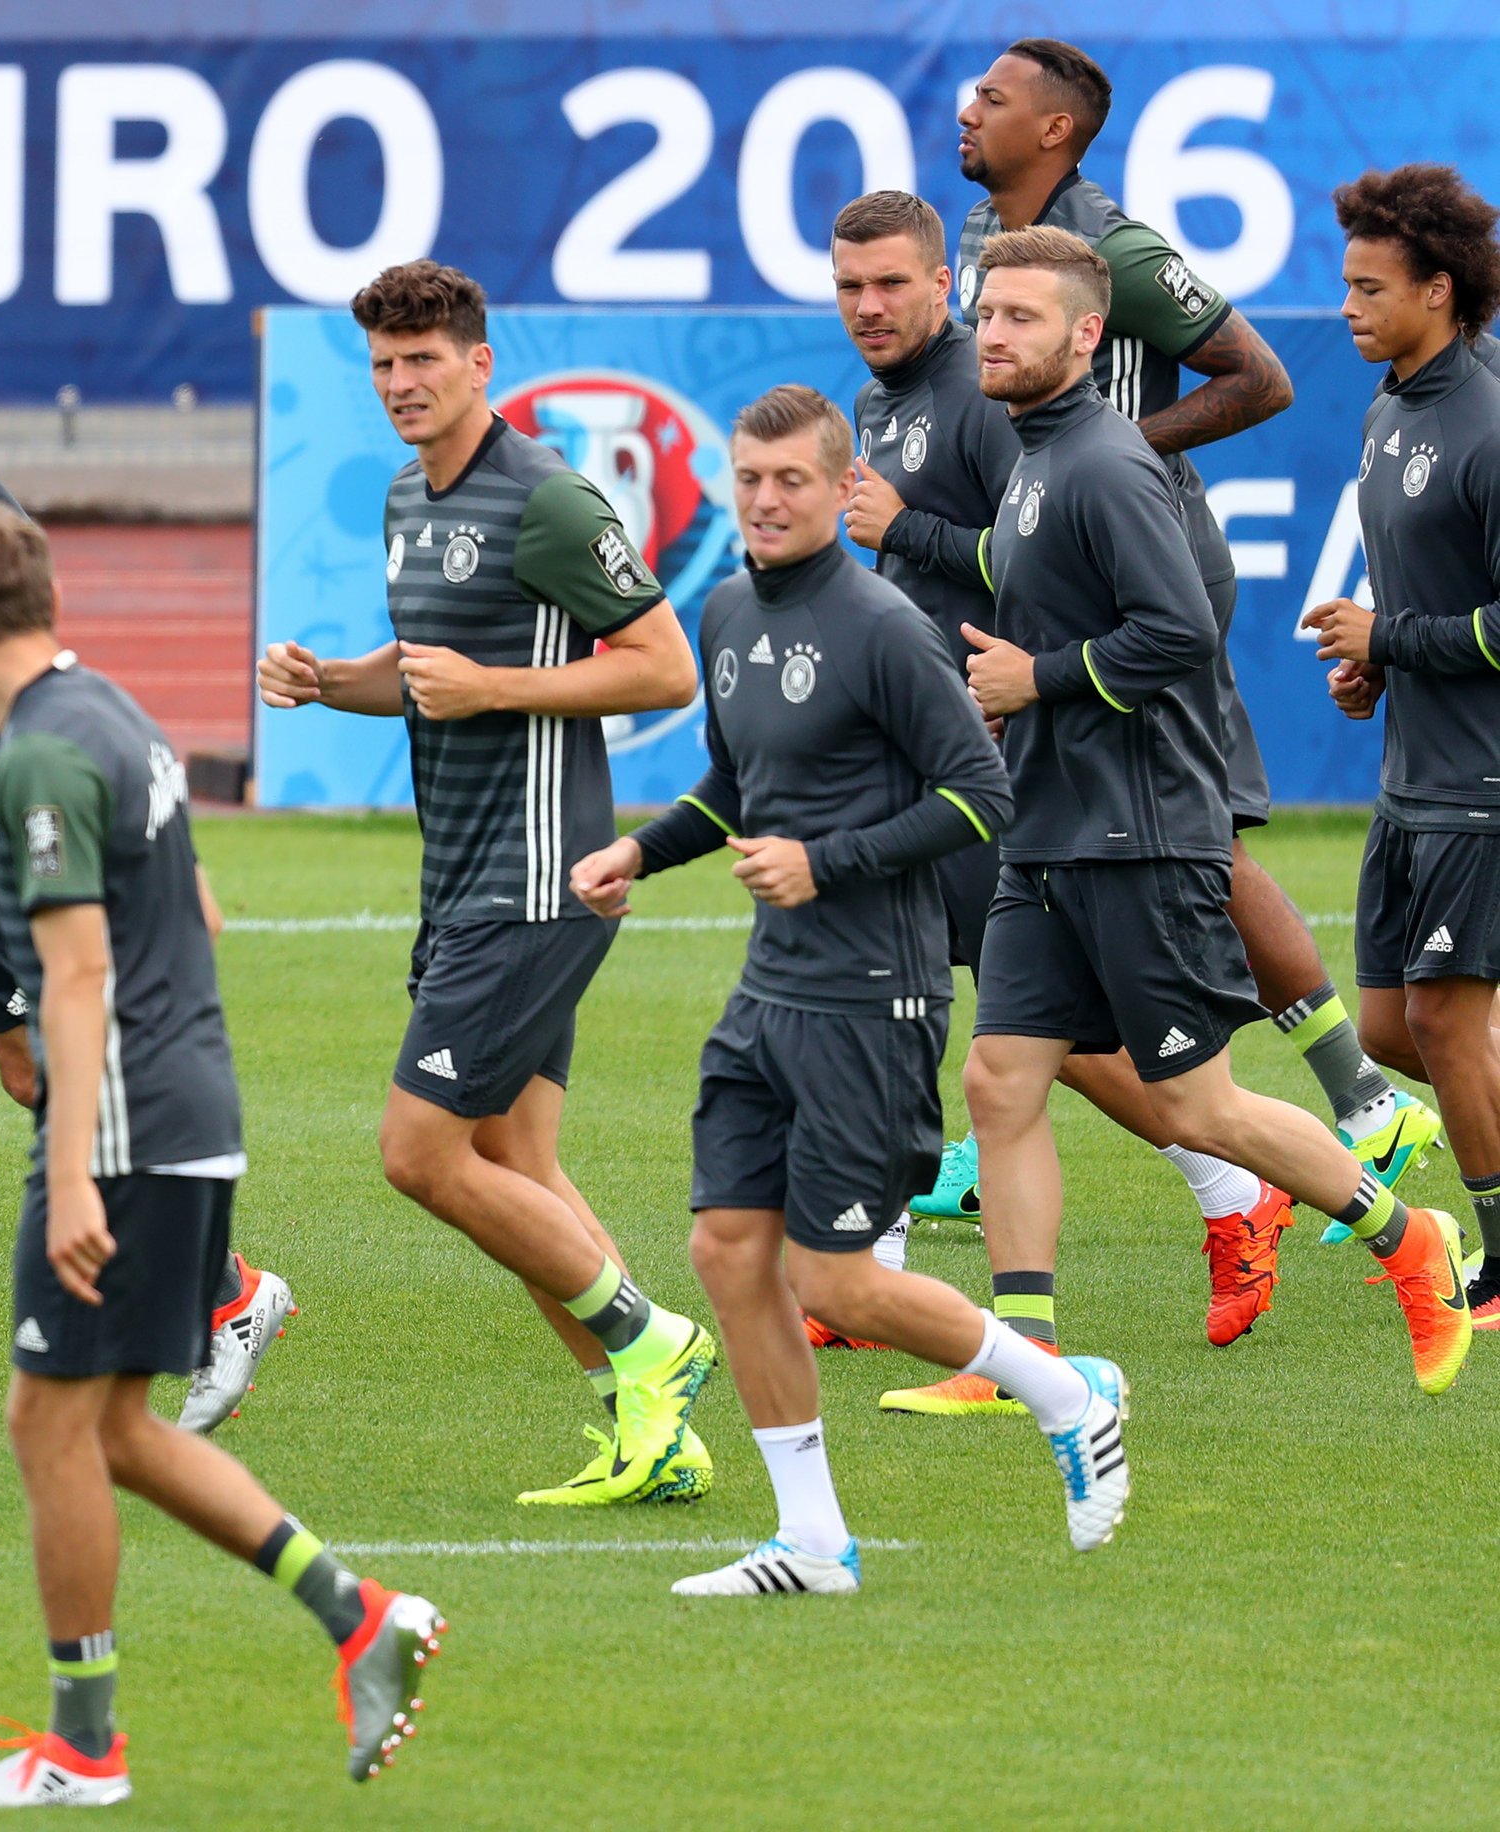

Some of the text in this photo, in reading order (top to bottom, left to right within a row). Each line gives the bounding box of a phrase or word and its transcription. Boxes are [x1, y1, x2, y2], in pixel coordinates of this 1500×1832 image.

[549, 65, 1294, 303] 206
[1157, 1037, 1197, 1059] adidas
[416, 1059, 459, 1081] adidas
[250, 1307, 267, 1361] adidas
